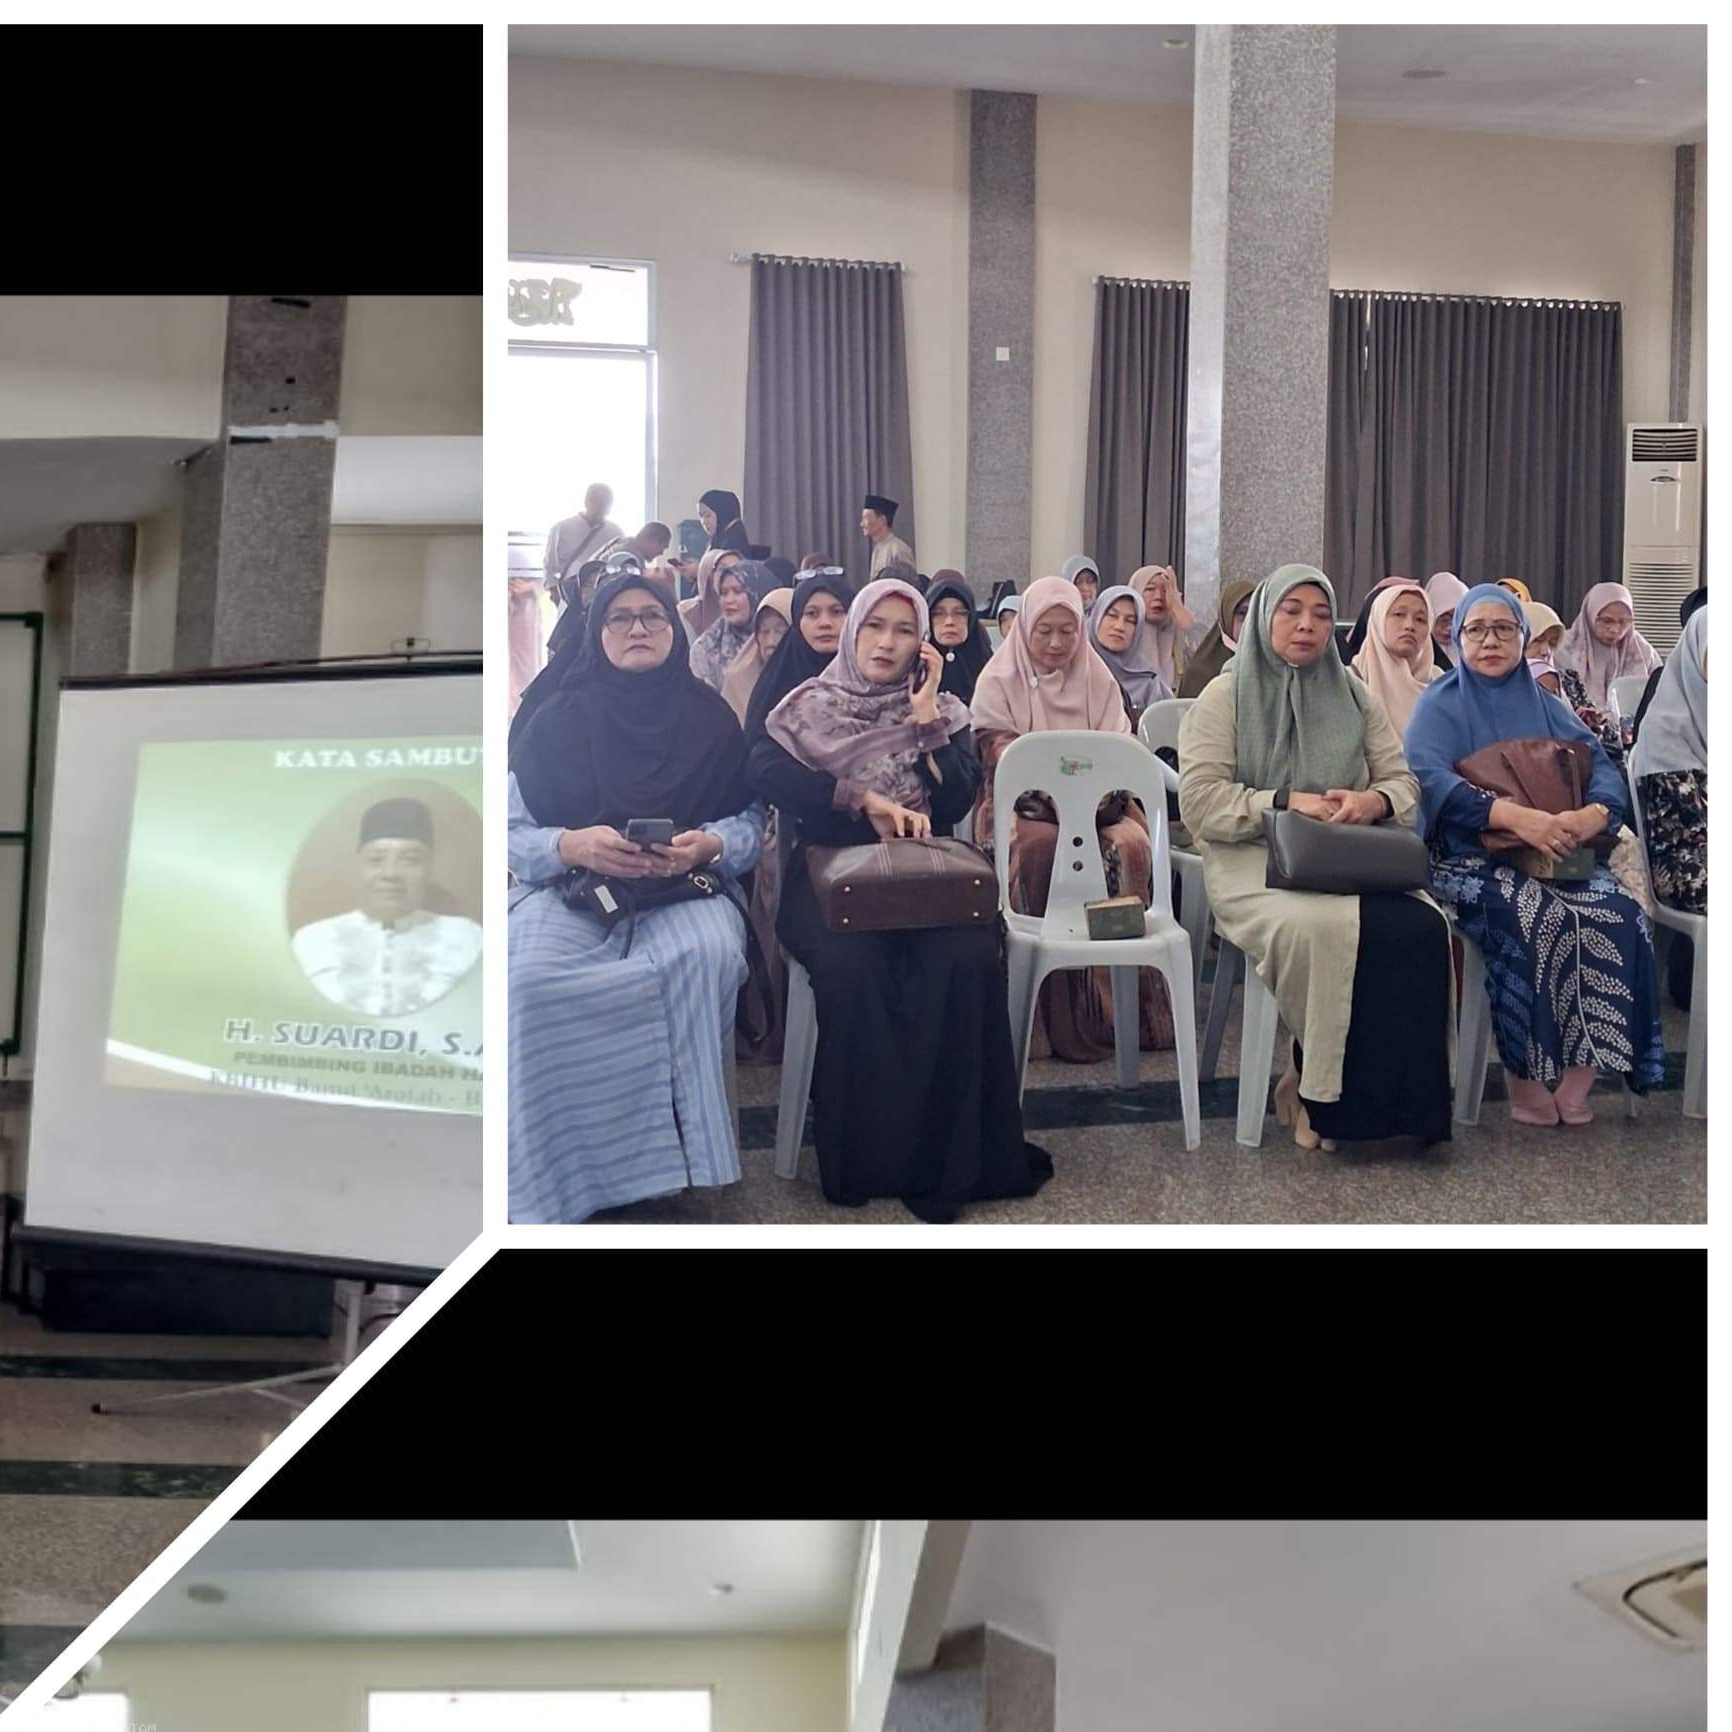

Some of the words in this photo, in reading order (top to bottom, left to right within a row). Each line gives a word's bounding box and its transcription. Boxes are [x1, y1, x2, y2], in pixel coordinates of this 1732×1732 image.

[275, 749, 357, 768] KATA
[364, 746, 483, 768] SAMBU
[225, 1019, 262, 1042] H.
[274, 1022, 428, 1056] SUARDI,
[440, 1031, 483, 1058] S.
[233, 1051, 367, 1075] PEMBIMBING
[372, 1061, 455, 1080] IBADAH
